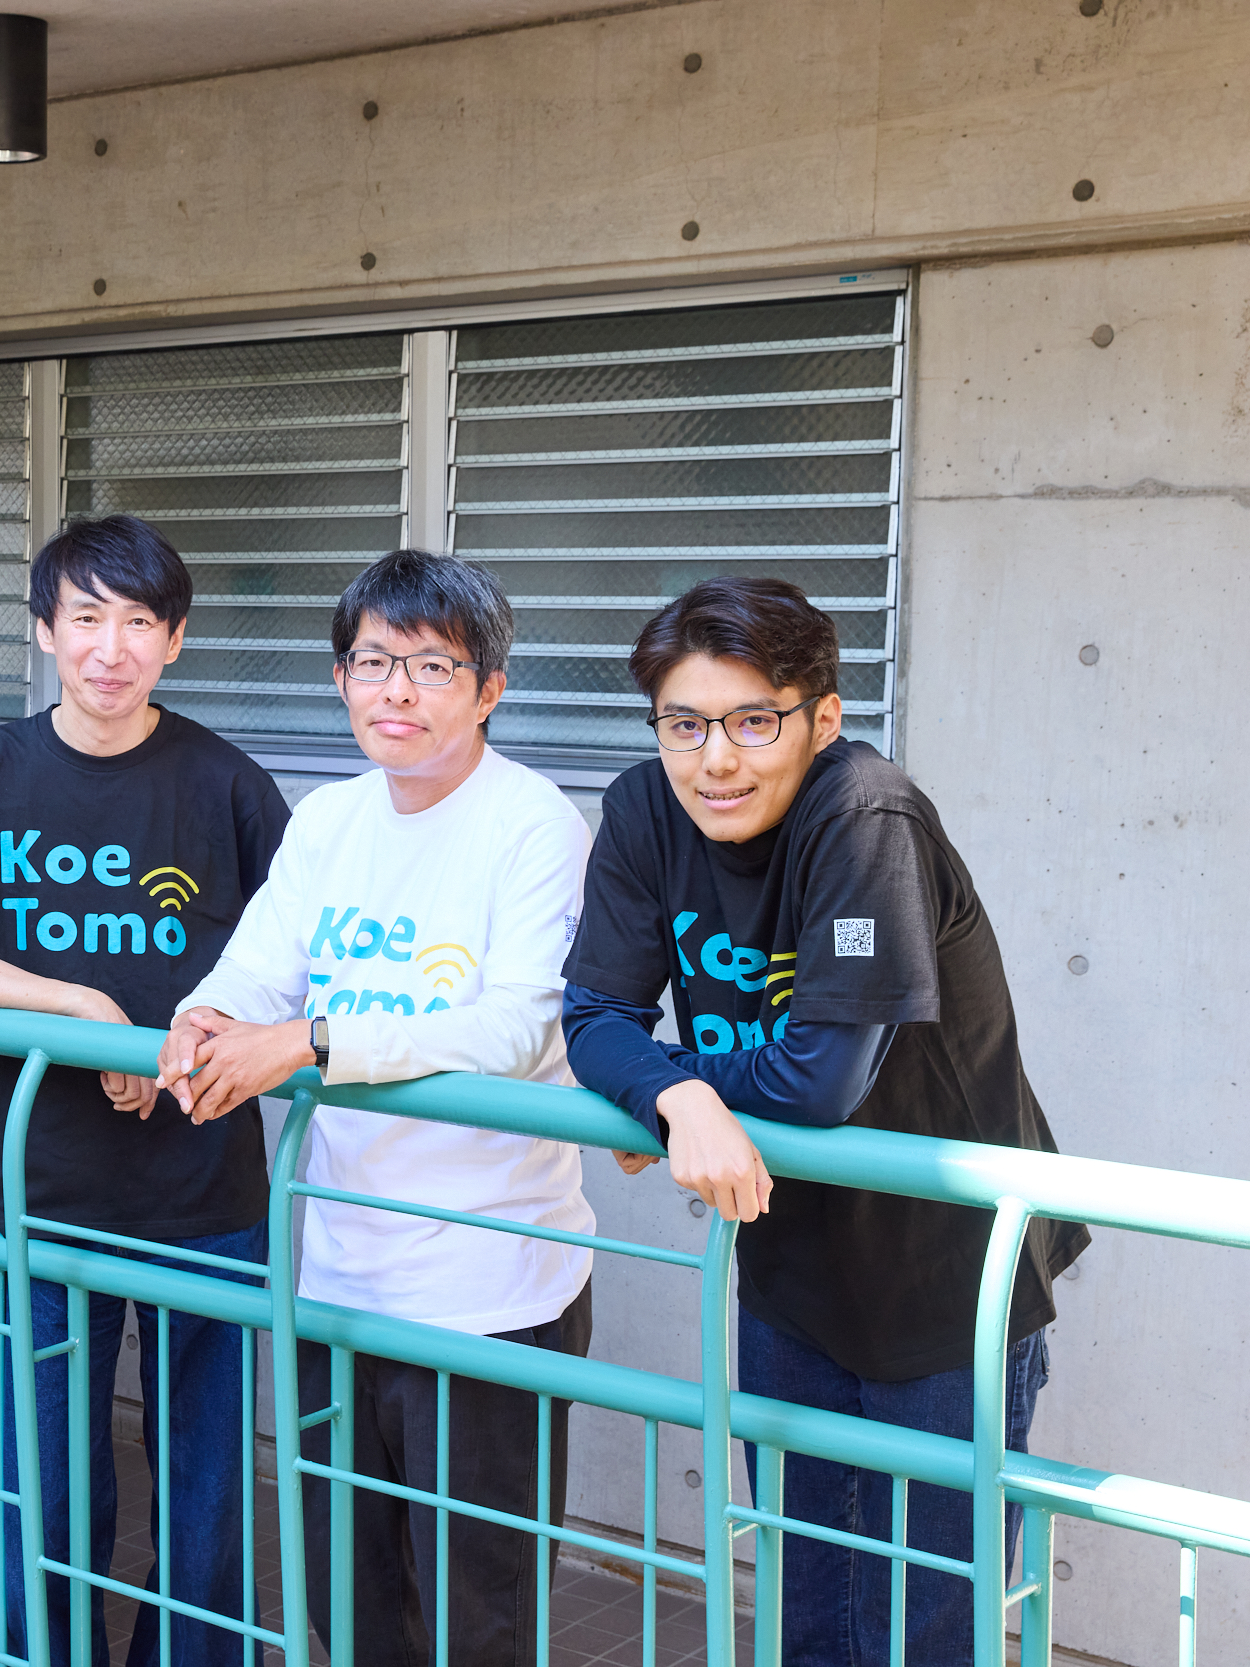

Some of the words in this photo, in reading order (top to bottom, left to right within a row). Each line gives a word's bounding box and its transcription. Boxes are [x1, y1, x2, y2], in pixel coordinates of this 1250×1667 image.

[0, 830, 132, 888] Koe
[2, 897, 187, 957] Tomo
[309, 906, 417, 963] Koe
